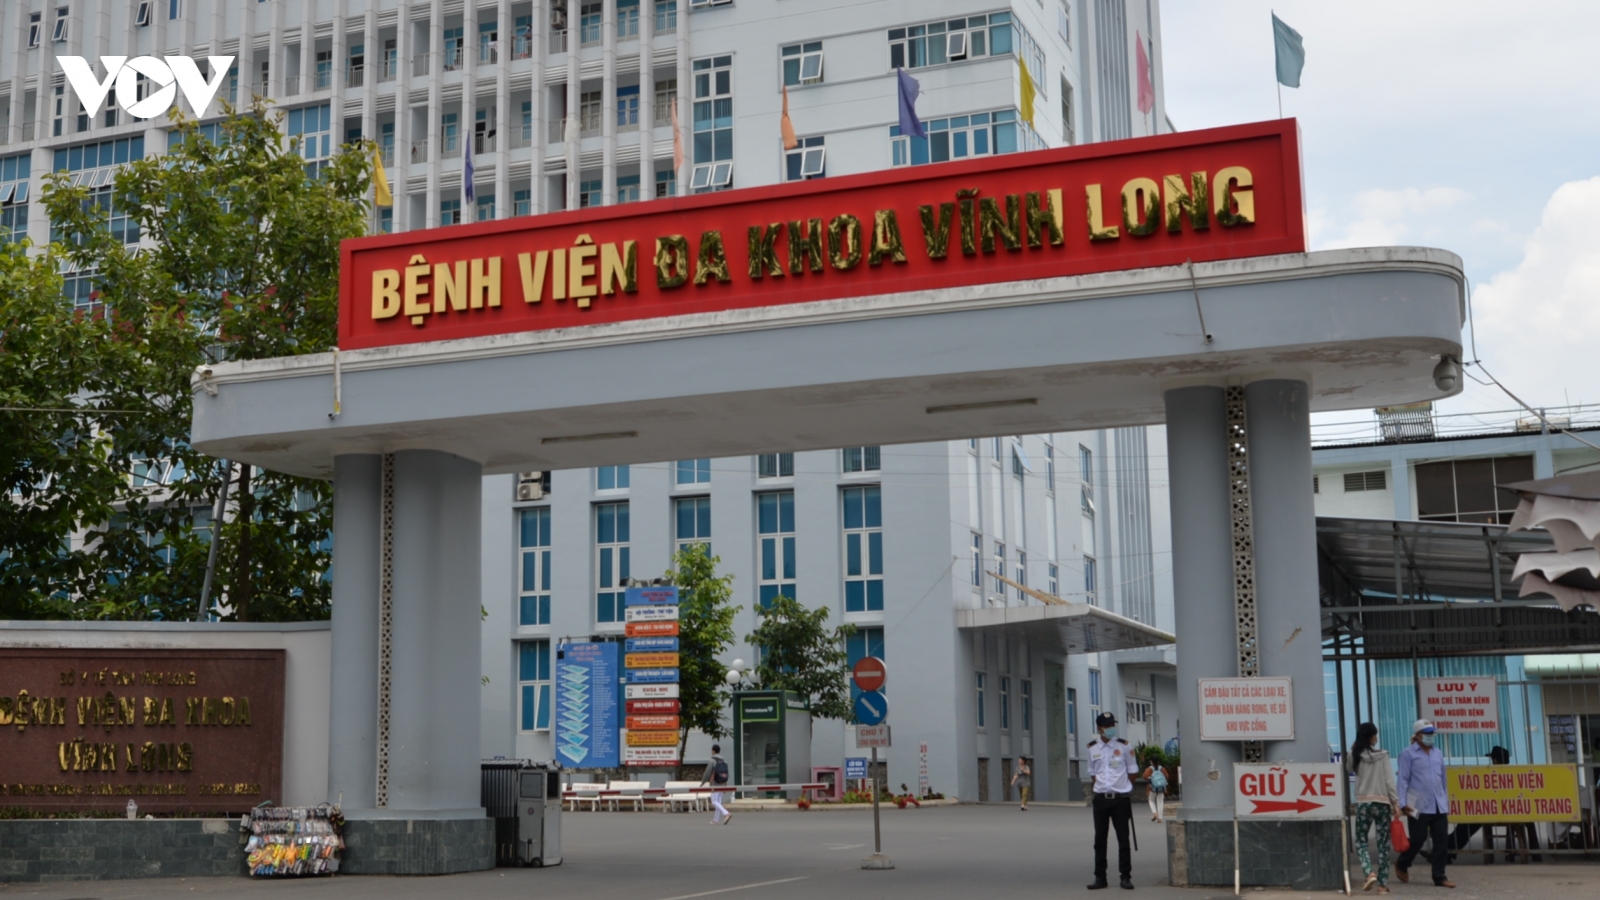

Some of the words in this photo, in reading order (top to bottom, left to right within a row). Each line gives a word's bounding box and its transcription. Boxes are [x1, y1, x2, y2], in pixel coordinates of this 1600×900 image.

[371, 254, 502, 325] BỆNH
[518, 234, 638, 308] VIỆN
[653, 230, 732, 290] ĐA
[747, 209, 907, 279] KHOA
[918, 187, 1064, 259] VĨNH
[1085, 165, 1256, 242] LONG
[80, 671, 88, 686] Y
[167, 671, 197, 686] LONG
[1437, 683, 1465, 692] LƯU
[1468, 681, 1478, 692] Ý
[1204, 684, 1217, 698] CẤM
[1231, 684, 1241, 698] TẤT
[1242, 684, 1250, 697] CẢ
[1251, 685, 1262, 697] CÁC
[1263, 686, 1276, 699] LOẠI
[1277, 686, 1286, 698] XE,
[1206, 702, 1221, 714] BUÔN
[1222, 702, 1234, 714] BÁN
[1235, 702, 1250, 714] HÀNG
[1252, 704, 1269, 715] RONG,
[1270, 702, 1277, 714] VÉ
[1278, 700, 1287, 714] SỐ
[1428, 697, 1440, 706] HẠN
[1441, 695, 1453, 704] CHẾ
[1474, 696, 1490, 706] BỆNH
[0, 689, 67, 732] BỆNH
[76, 690, 136, 733] VIỆN
[143, 696, 177, 726] ĐA
[184, 696, 252, 727] KHOA
[1448, 708, 1467, 716] NGƯỜI
[1468, 708, 1484, 718] BỆNH
[1226, 721, 1238, 732] KHU
[1239, 720, 1250, 734] VỰC
[1251, 717, 1267, 732] CỔNG
[1437, 721, 1453, 730] ĐƯỢC
[1460, 720, 1479, 729] NGƯỜI
[1481, 720, 1496, 728] NUÔI
[57, 735, 118, 772] VĨNH
[125, 741, 193, 772] LONG
[1239, 767, 1289, 796] GIỮ
[1300, 773, 1336, 796] XE
[1458, 771, 1480, 790] VÀO
[1484, 770, 1514, 793] BỆNH
[1517, 770, 1544, 793] VIỆN
[1464, 799, 1498, 815] MANG
[1502, 793, 1531, 815] KHẨU
[1534, 798, 1572, 814] TRANG
